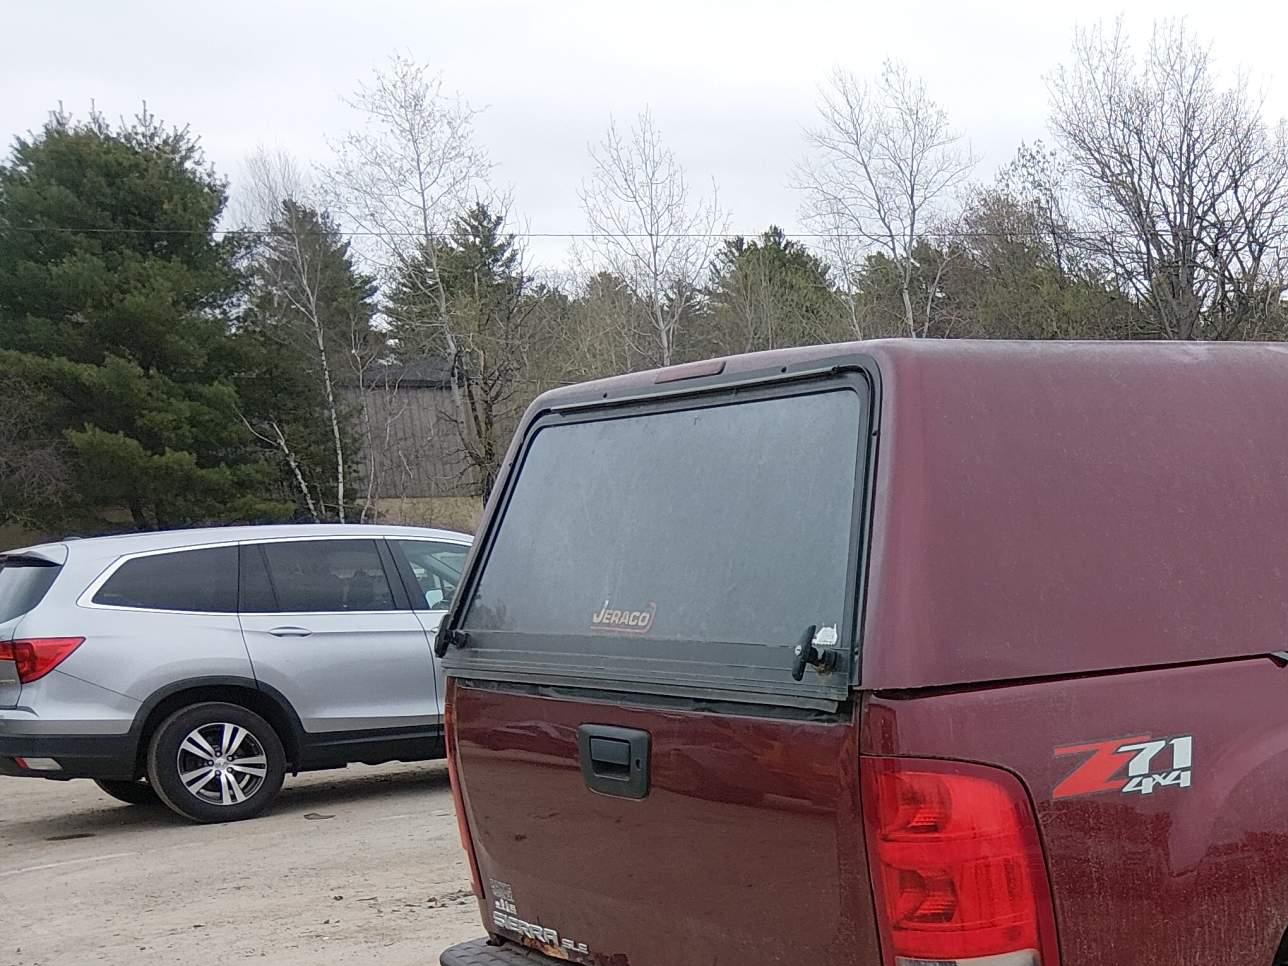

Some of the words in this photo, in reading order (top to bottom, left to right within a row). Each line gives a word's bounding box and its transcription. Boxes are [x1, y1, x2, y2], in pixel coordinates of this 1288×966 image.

[592, 600, 650, 626] JERACO
[1053, 736, 1192, 798] Z71
[493, 910, 559, 946] SIERRA
